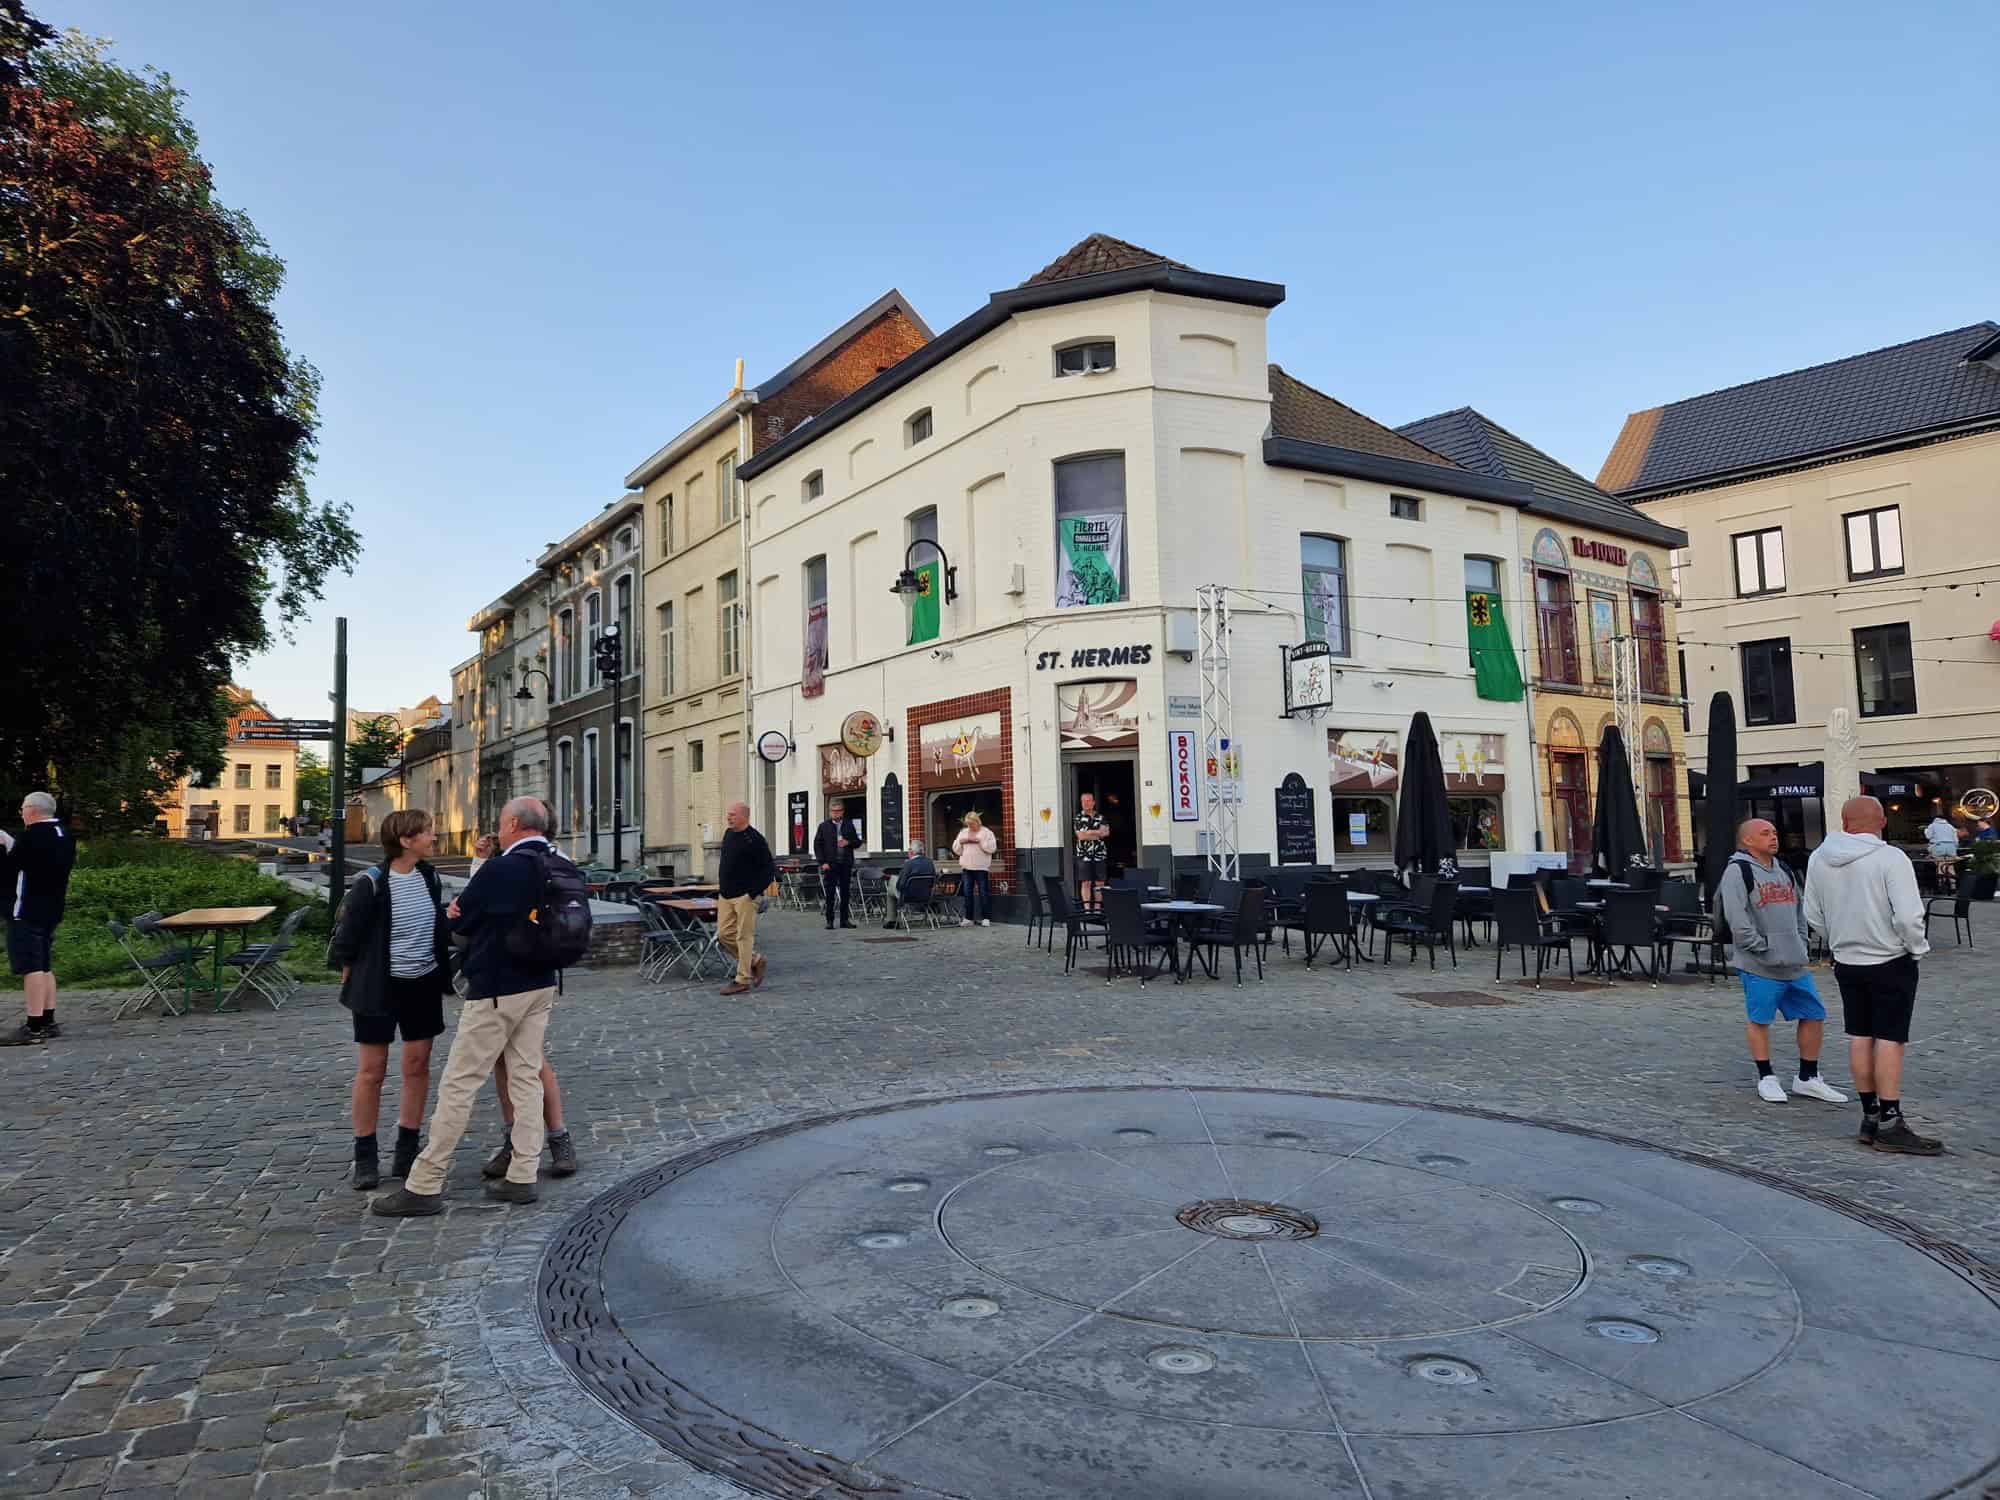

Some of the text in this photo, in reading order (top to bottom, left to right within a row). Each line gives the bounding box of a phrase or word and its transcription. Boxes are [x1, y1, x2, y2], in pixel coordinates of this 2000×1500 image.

[1074, 520, 1109, 532] FIERTEL
[1590, 541, 1627, 566] TOWER
[1036, 644, 1152, 670] ST. HERMES
[1178, 735, 1191, 808] BOCKOR
[1778, 785, 1816, 795] ENAME
